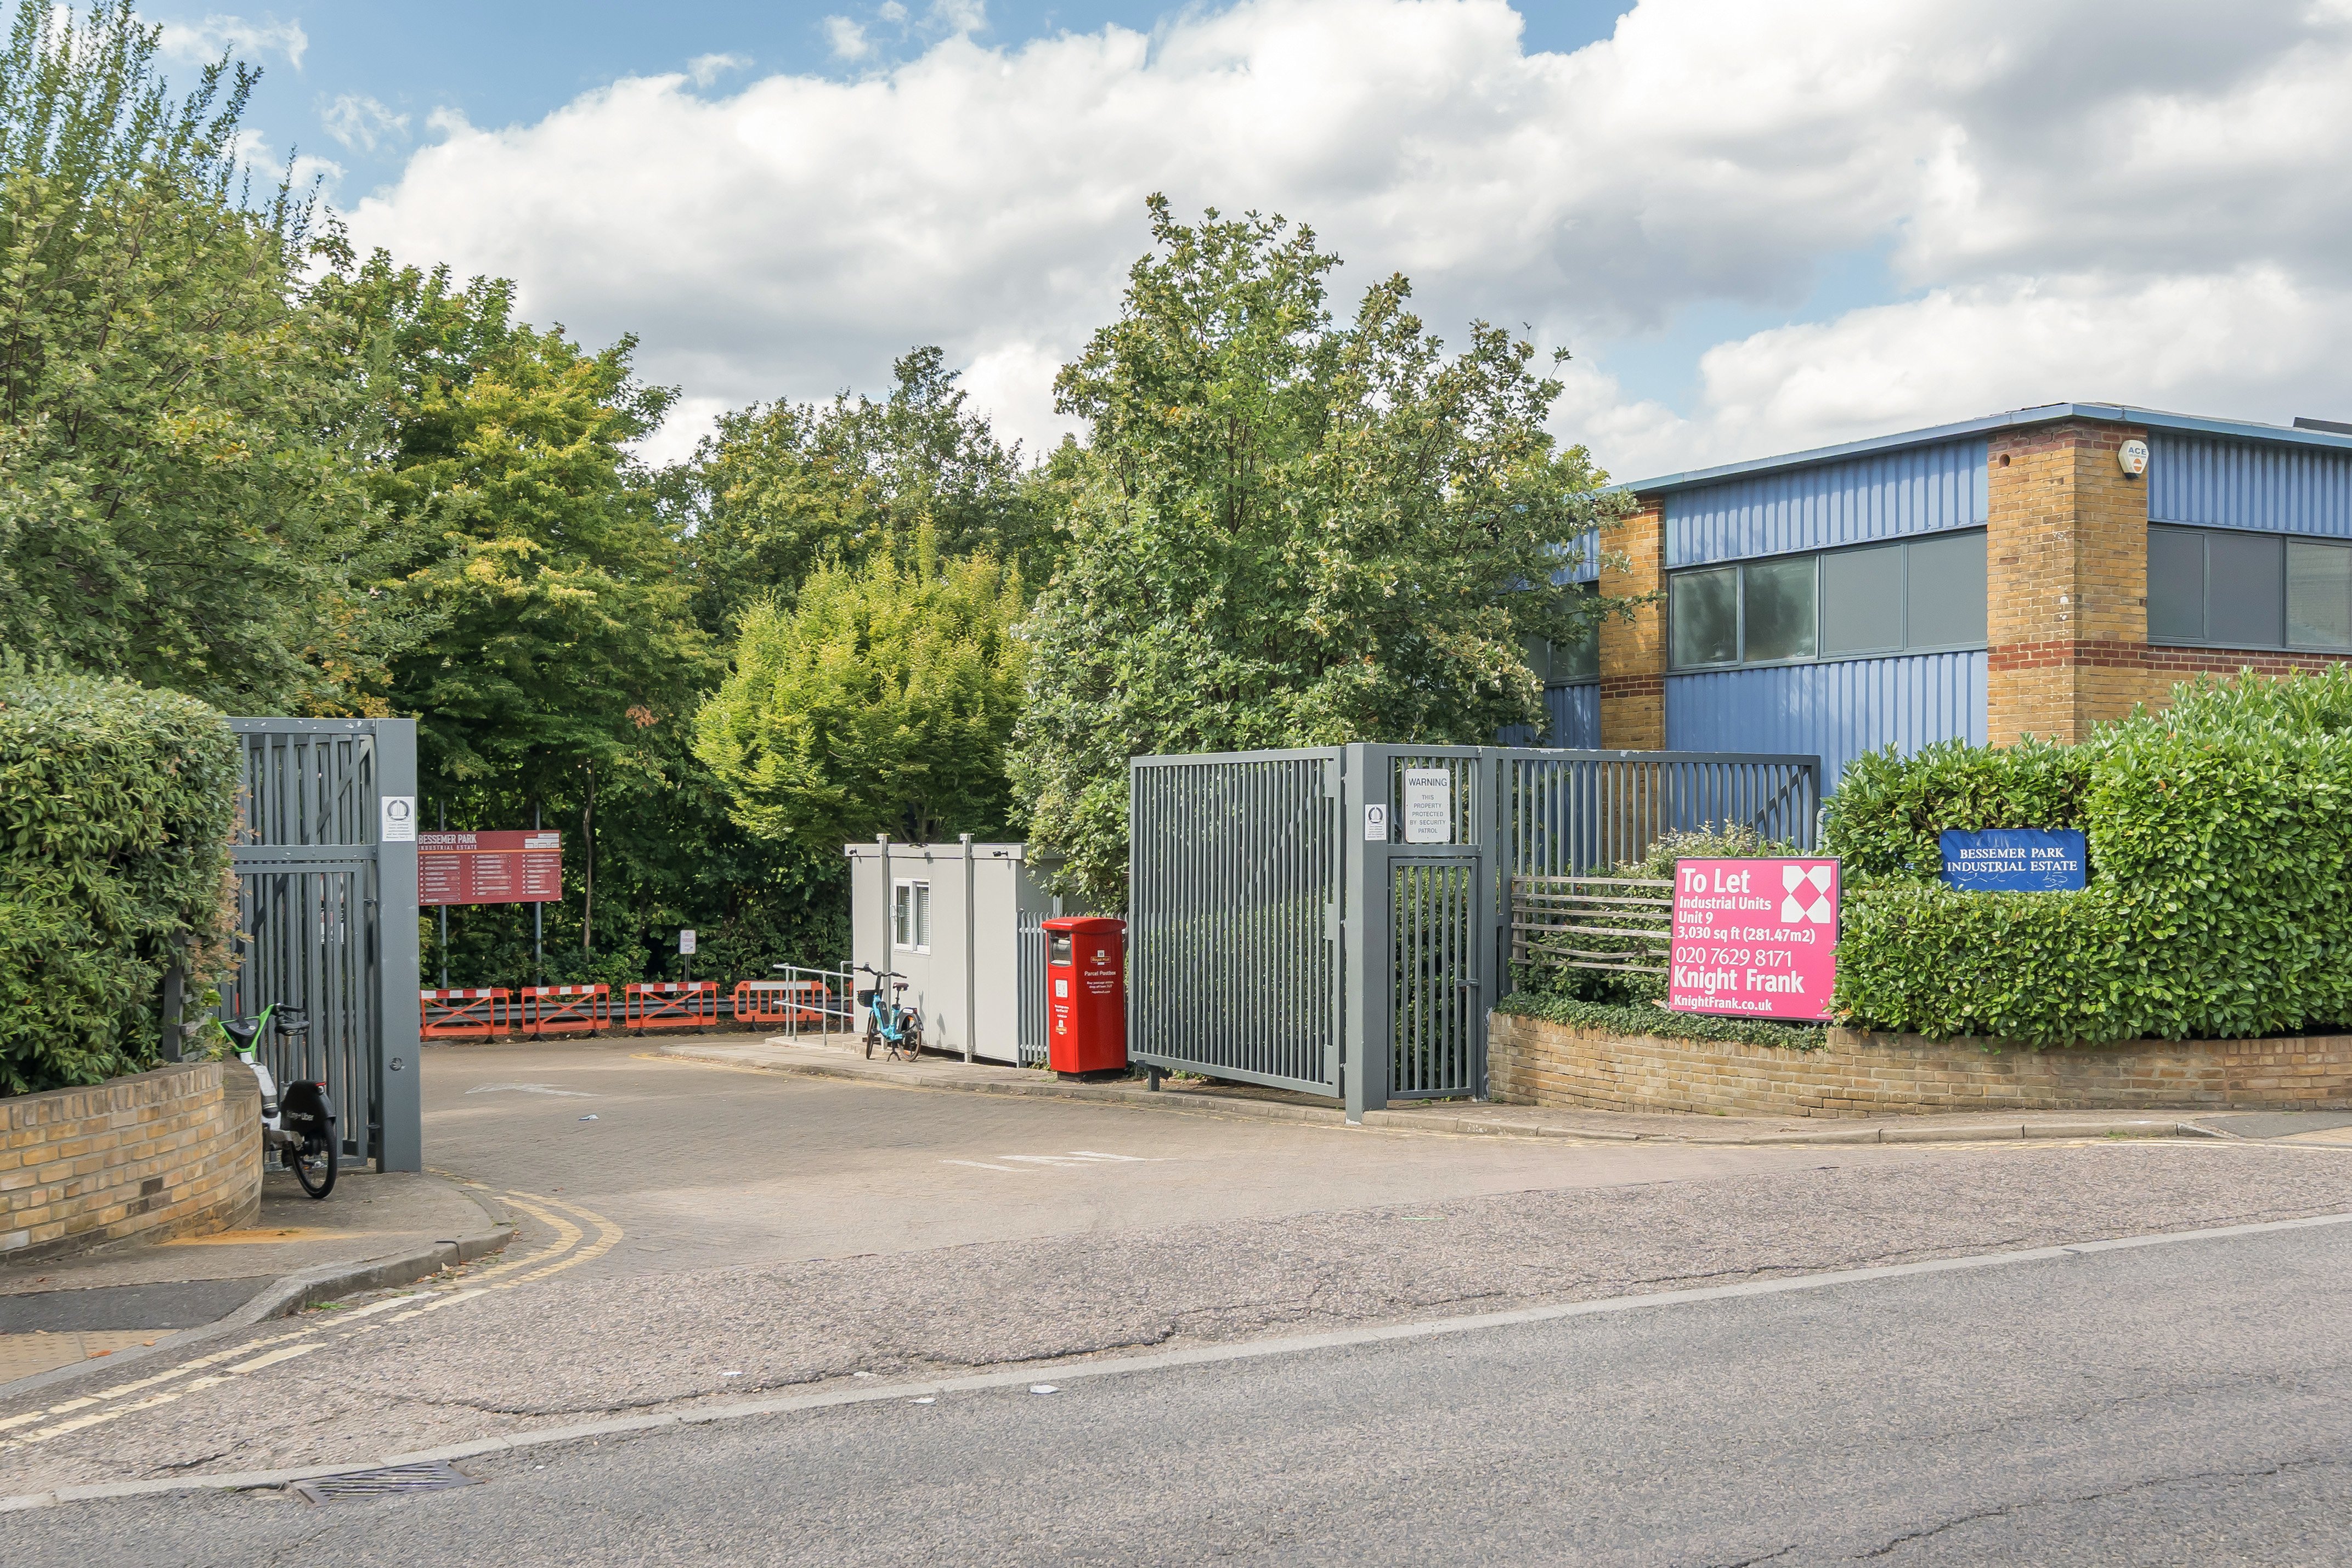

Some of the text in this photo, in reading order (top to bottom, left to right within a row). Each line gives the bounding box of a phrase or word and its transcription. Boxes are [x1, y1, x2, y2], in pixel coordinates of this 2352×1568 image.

[2128, 446, 2147, 455] ACE
[1408, 778, 1448, 786] WARNING
[418, 834, 477, 845] BESSEMER PARK
[1959, 847, 2065, 859] BESSEMER PARK
[1947, 861, 2078, 872] INDUSTRIAL ESTATE
[1681, 868, 1751, 894] To Let
[1679, 895, 1772, 910] Industrial Units
[1678, 910, 1714, 925] Unit 9
[1677, 926, 1816, 945] 3,030 sq ft (281.47m2)
[1676, 946, 1792, 967] 020 7629 8171
[1673, 965, 1806, 995] Knight Frank
[1673, 994, 1773, 1011] KnightFrank.co.uk
